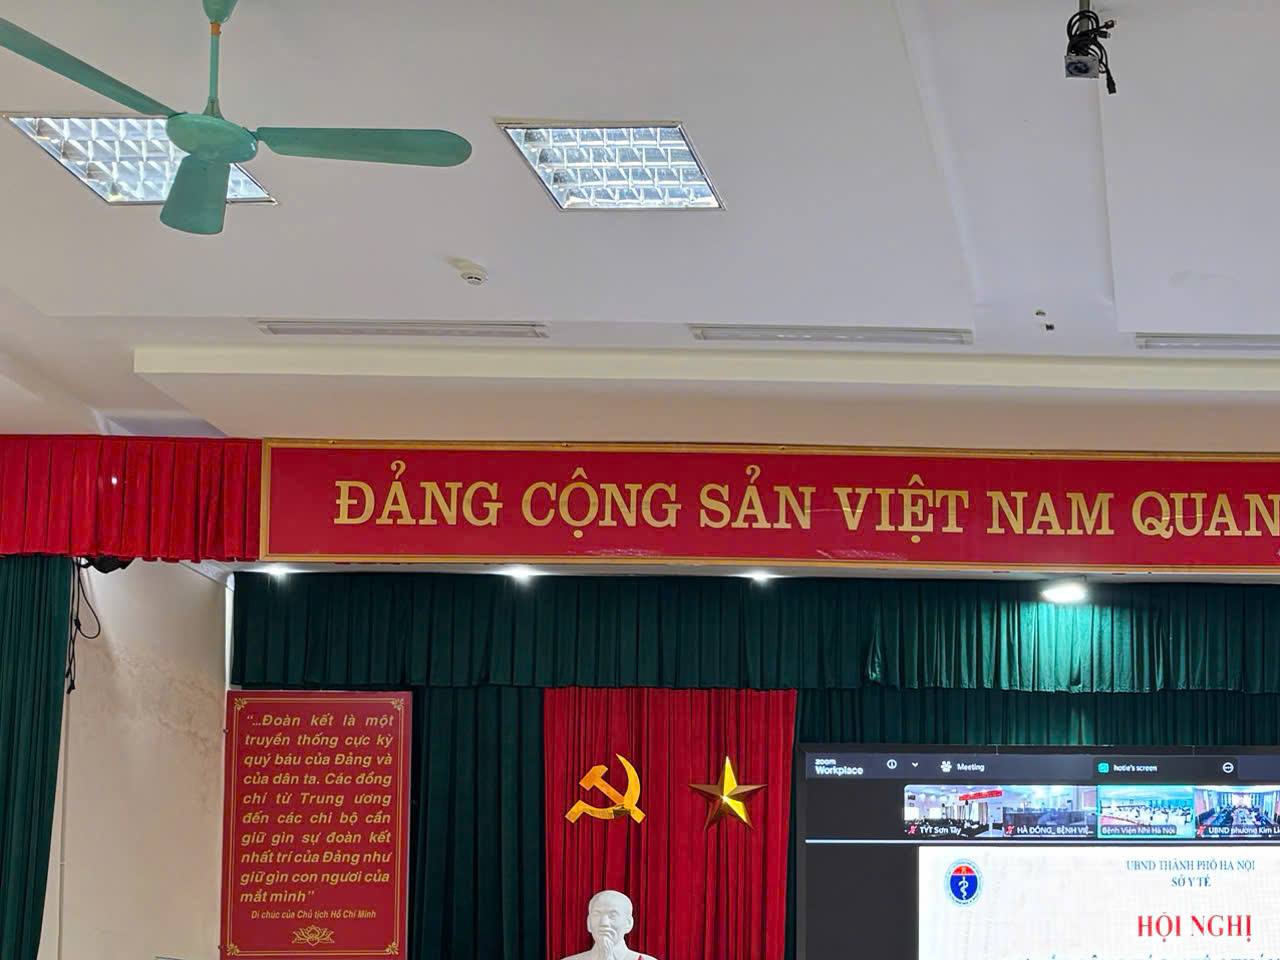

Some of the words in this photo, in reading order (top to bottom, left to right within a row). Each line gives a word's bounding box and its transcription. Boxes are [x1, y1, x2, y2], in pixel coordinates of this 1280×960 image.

[334, 460, 501, 525] ĐẢNG
[523, 468, 681, 538] CỘNG
[701, 466, 815, 529] SẢN
[834, 474, 969, 543] VIỆT
[987, 492, 1114, 535] NAM
[311, 713, 334, 726] kết
[343, 715, 356, 726] là
[365, 715, 394, 728] một
[298, 732, 338, 748] thống
[275, 753, 300, 765] báu
[305, 752, 330, 765] của
[335, 752, 371, 767] Đảng
[377, 753, 392, 765] và
[815, 765, 863, 775] Workplace
[957, 763, 985, 772] Meeting
[243, 772, 269, 784] của
[273, 773, 299, 784] dân
[304, 774, 319, 784] ta.
[325, 773, 352, 784] Các
[243, 793, 267, 804] chí
[301, 793, 344, 806] Trung
[354, 794, 391, 806] ương
[278, 812, 302, 823] các
[310, 812, 332, 823] chi
[340, 812, 357, 825] bộ
[369, 830, 391, 843] kết
[241, 850, 274, 863] nhất
[294, 850, 319, 863] của
[323, 850, 360, 865] Đảng
[1126, 860, 1156, 871] UBND
[292, 873, 317, 882] con
[364, 869, 389, 882] của
[1171, 875, 1186, 887] SỞ
[1188, 877, 1196, 887] Y
[1197, 874, 1211, 887] TẾ
[1138, 912, 1181, 942] HỘI
[1190, 915, 1252, 942] NGHỊ
